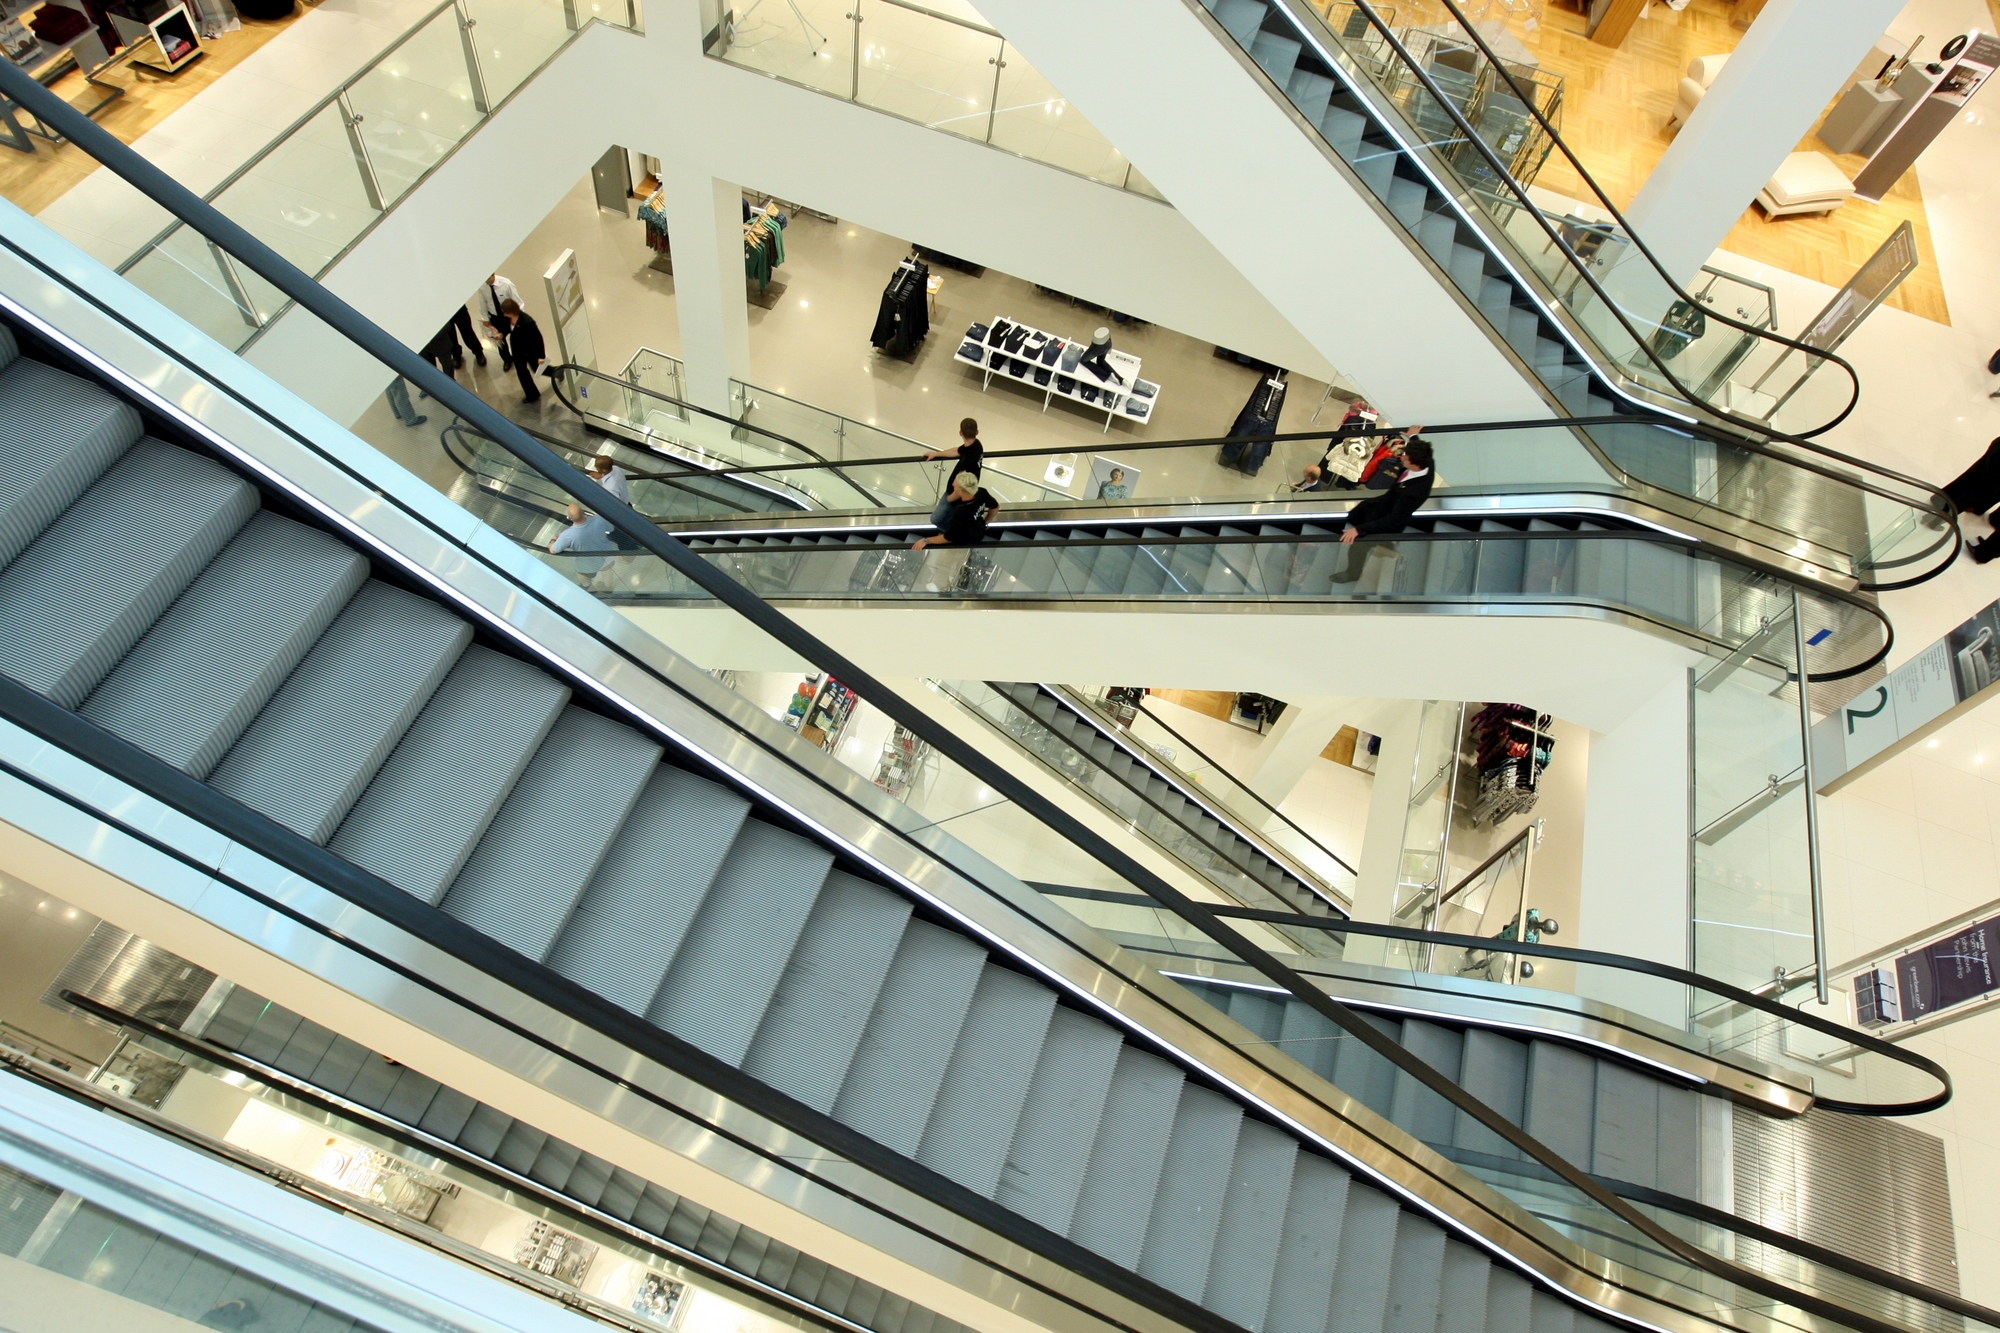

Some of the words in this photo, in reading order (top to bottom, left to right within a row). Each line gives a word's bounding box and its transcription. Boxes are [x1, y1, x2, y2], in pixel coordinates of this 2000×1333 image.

[1846, 685, 1888, 736] 2
[1960, 936, 1968, 952] John
[1978, 929, 1986, 951] Home
[1982, 951, 1992, 985] Insurance
